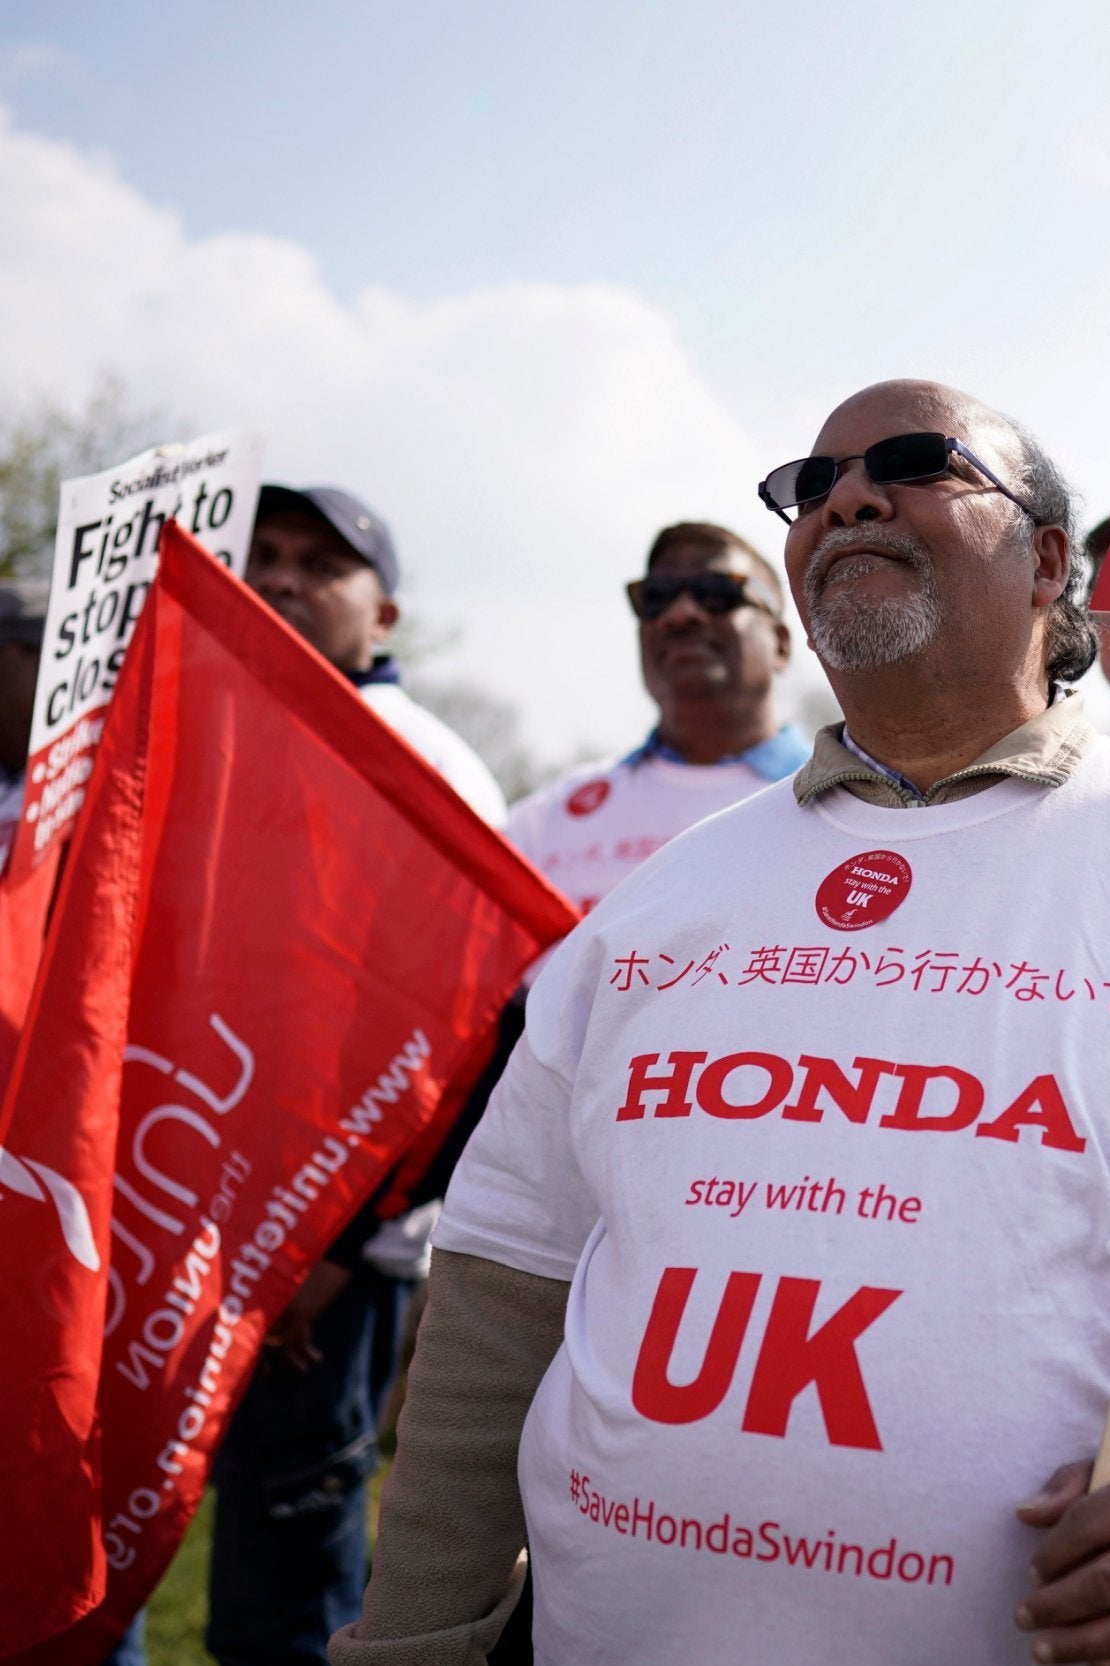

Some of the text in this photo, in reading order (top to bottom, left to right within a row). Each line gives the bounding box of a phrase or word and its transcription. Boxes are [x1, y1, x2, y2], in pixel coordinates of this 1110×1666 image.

[191, 482, 233, 534] to
[46, 648, 128, 728] clos
[844, 877, 892, 896] stay with the
[846, 890, 873, 908] UK
[850, 866, 898, 885] HONDA
[616, 1051, 1087, 1154] HONDA
[685, 1176, 923, 1224] stay with the
[631, 1266, 905, 1453] UK
[570, 1468, 955, 1587] #SaveHondaSwindon
